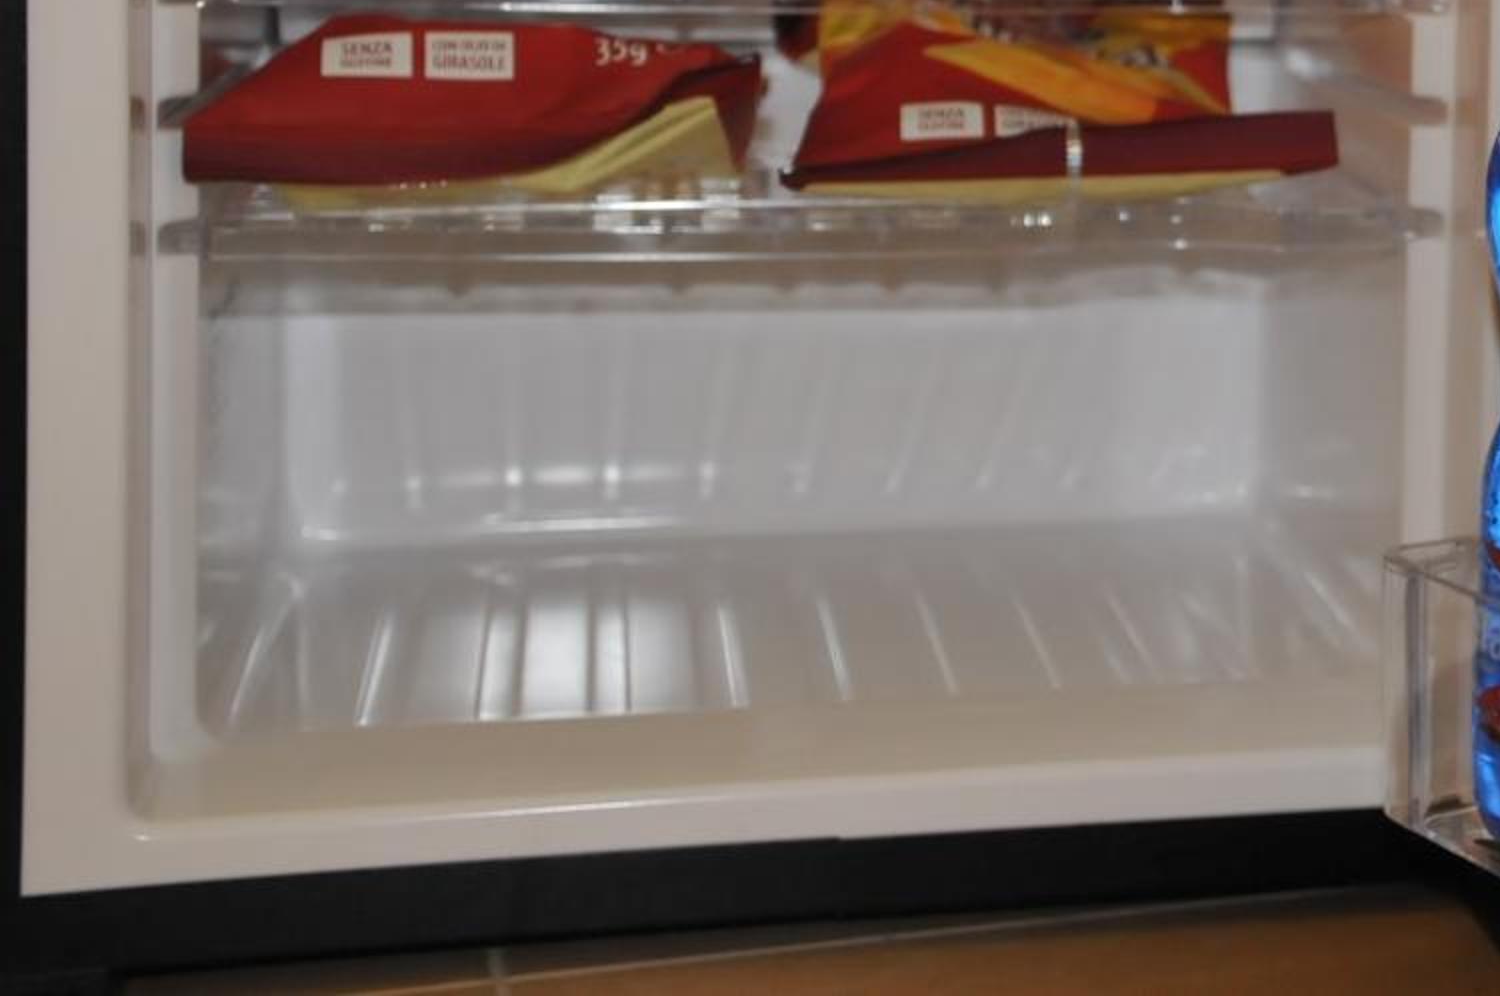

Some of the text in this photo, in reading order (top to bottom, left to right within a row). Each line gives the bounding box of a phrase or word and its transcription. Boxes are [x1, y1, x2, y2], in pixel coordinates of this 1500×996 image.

[341, 40, 393, 54] SENZA
[594, 37, 649, 68] 35g
[431, 56, 506, 72] GIRASOLE
